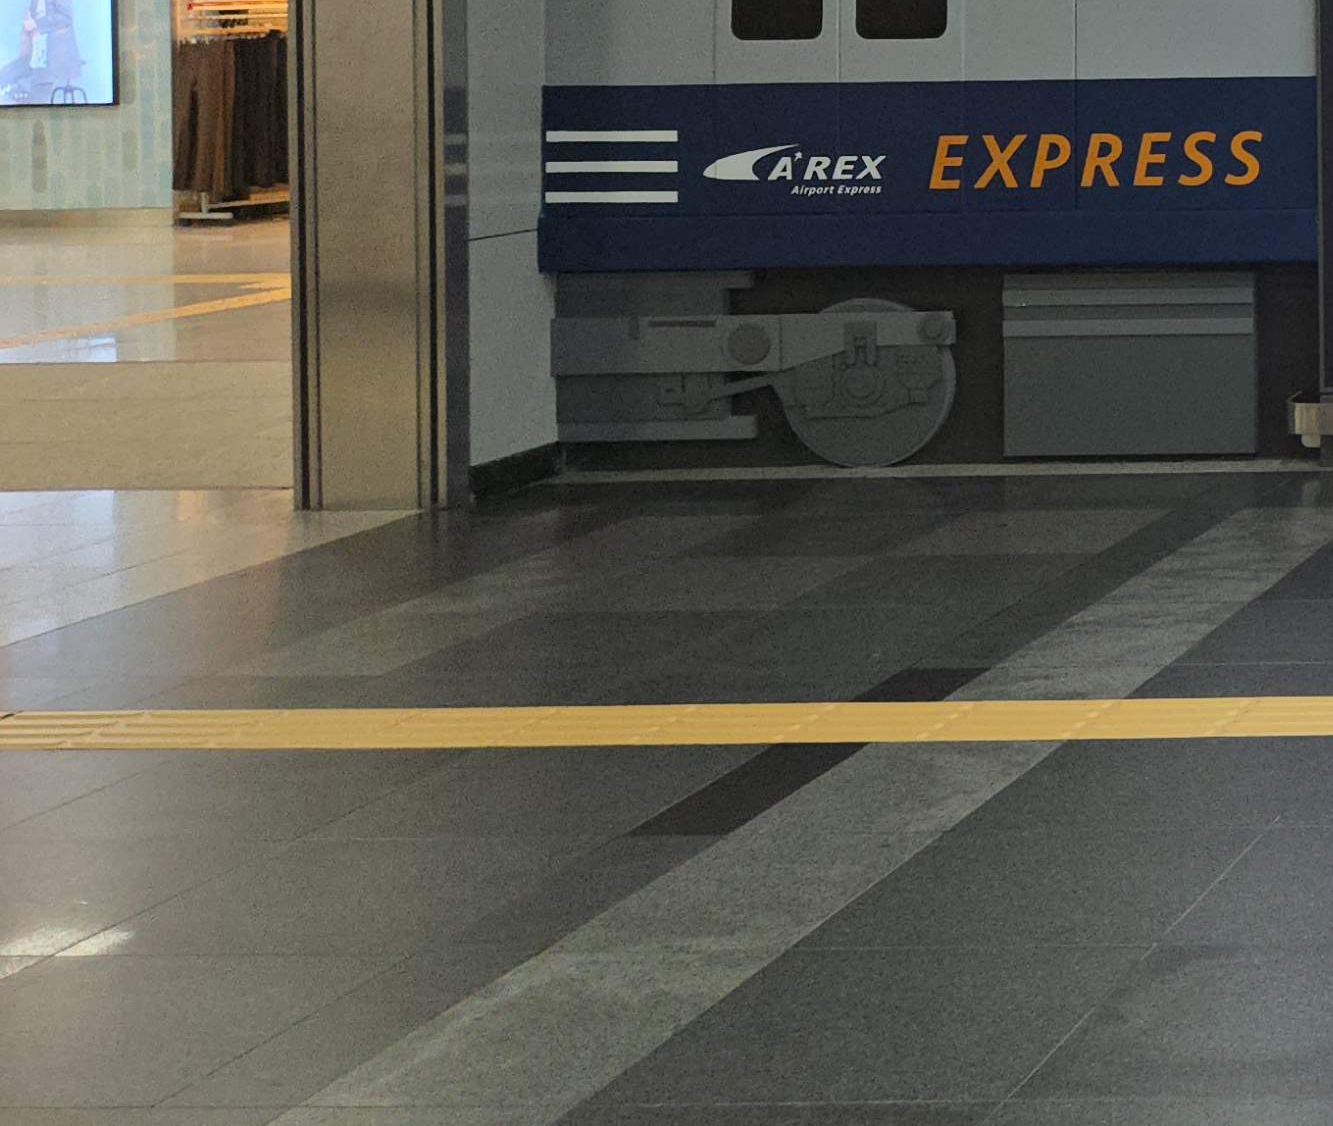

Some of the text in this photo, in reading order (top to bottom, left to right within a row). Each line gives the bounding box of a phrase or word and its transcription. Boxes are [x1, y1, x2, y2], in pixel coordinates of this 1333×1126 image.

[929, 130, 1264, 190] EXPRESS
[791, 184, 882, 197] Airport Express
